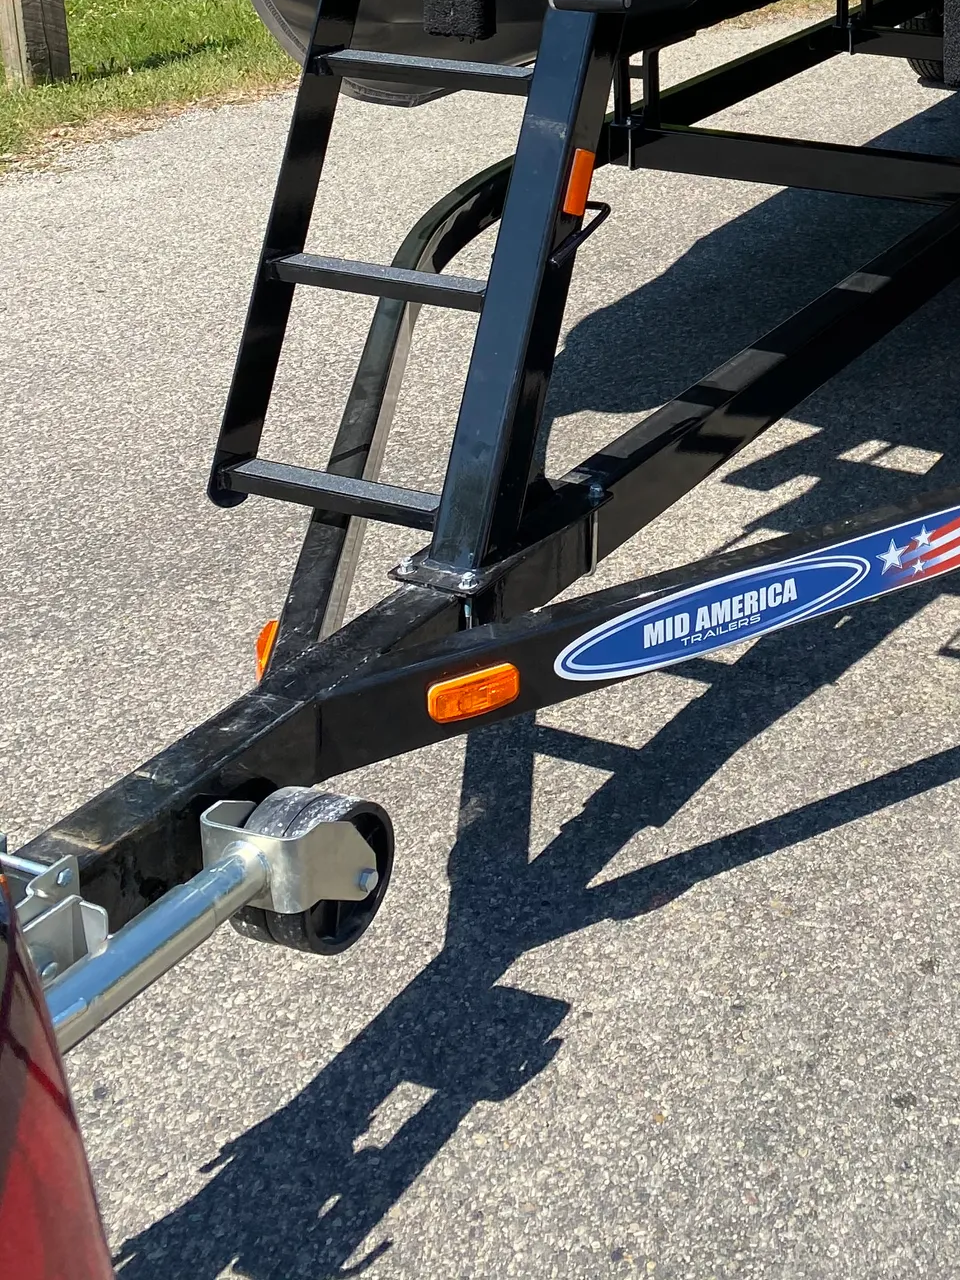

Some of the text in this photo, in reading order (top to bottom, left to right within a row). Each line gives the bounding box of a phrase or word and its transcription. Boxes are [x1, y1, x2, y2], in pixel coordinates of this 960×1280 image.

[643, 578, 797, 649] MID AMERICA
[681, 614, 761, 646] TRAILERS
